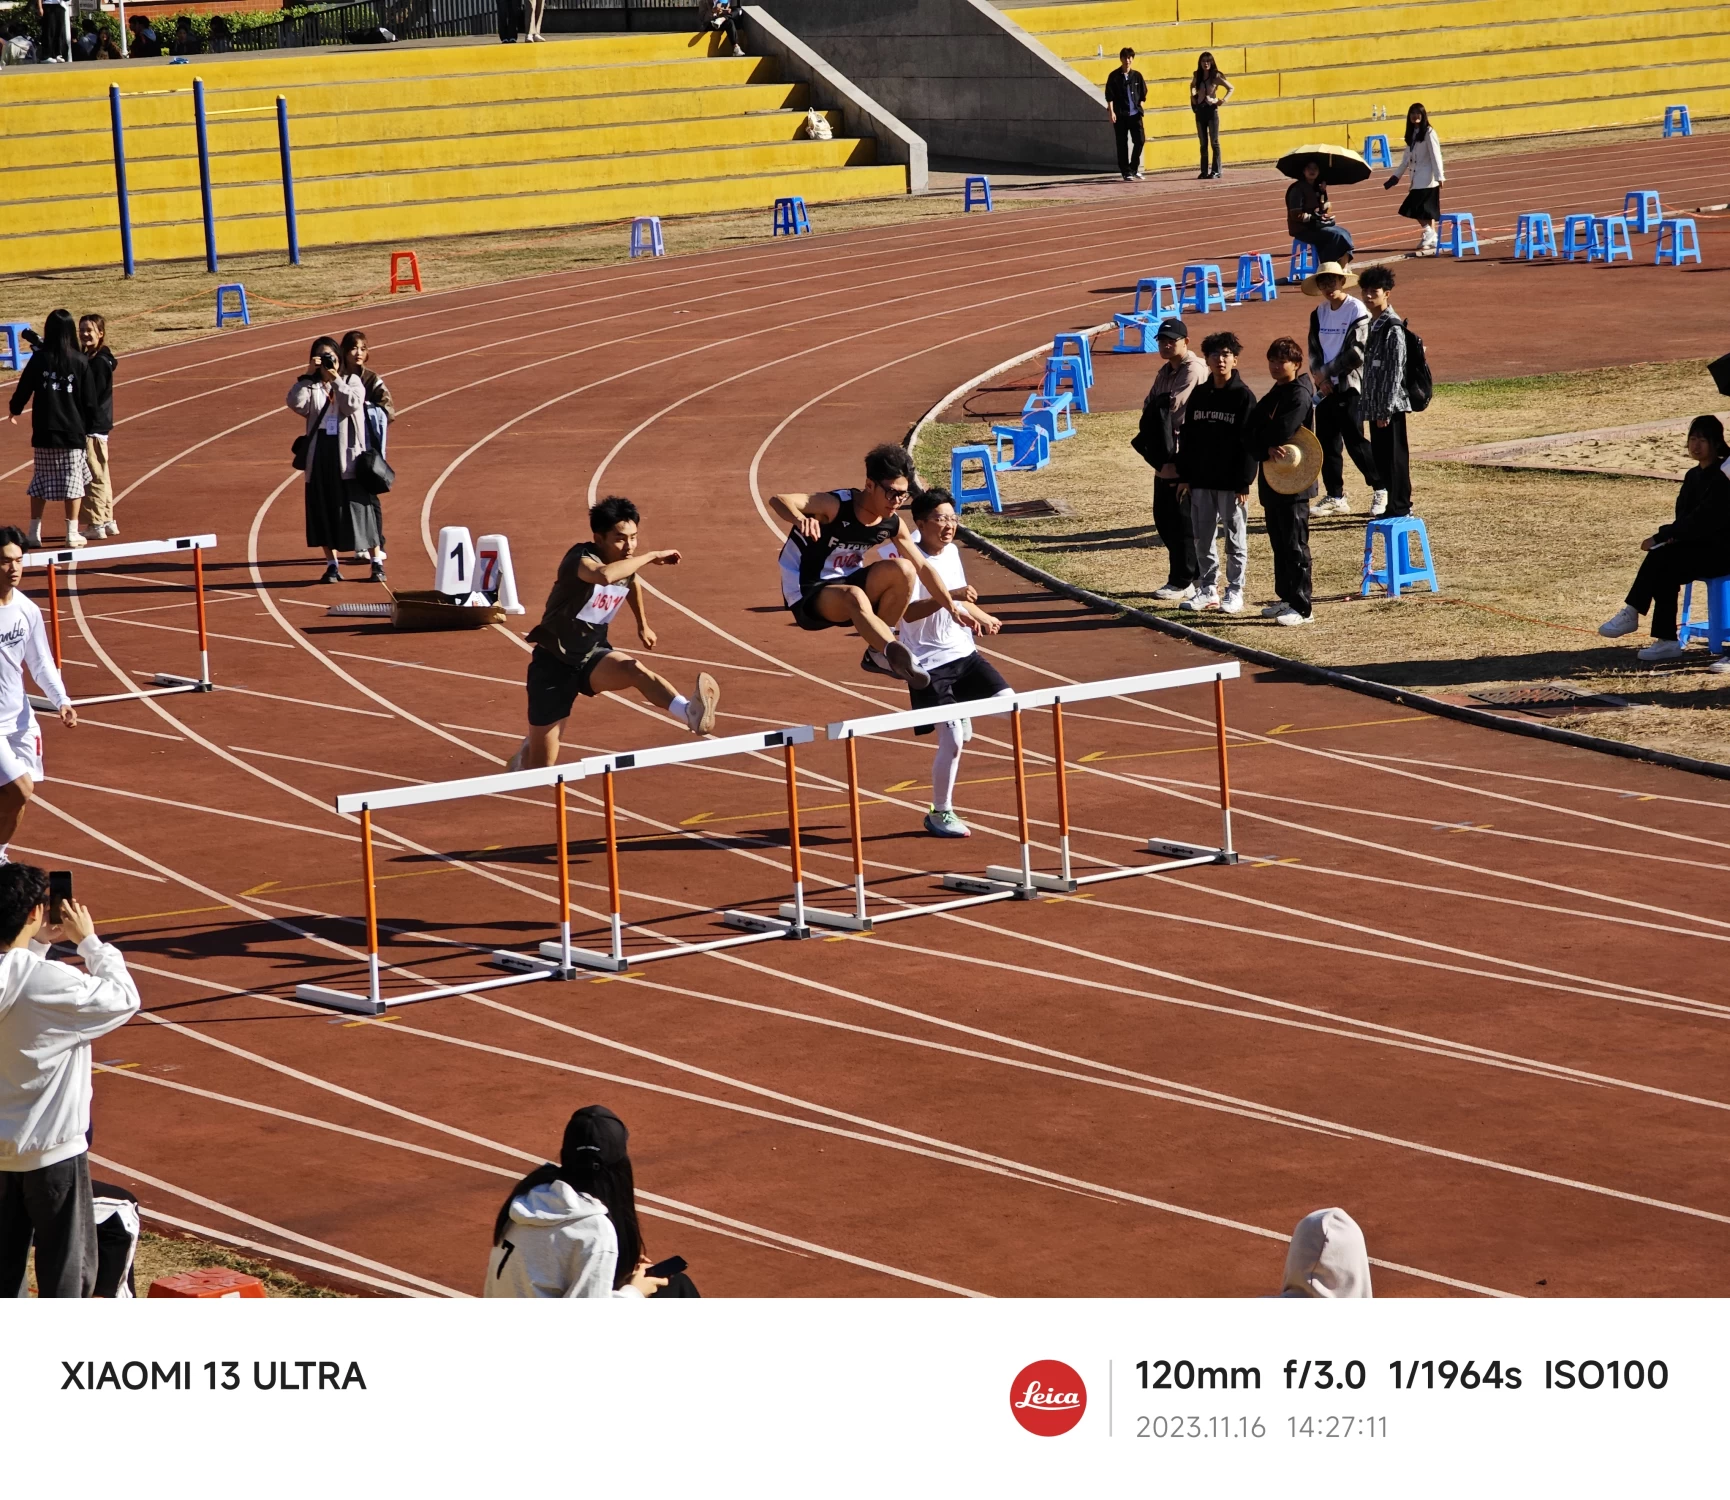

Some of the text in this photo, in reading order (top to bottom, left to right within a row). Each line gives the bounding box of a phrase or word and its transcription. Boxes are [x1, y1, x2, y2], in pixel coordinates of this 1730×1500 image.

[450, 542, 464, 581] 1
[480, 551, 498, 590] 7
[497, 1239, 515, 1280] 7
